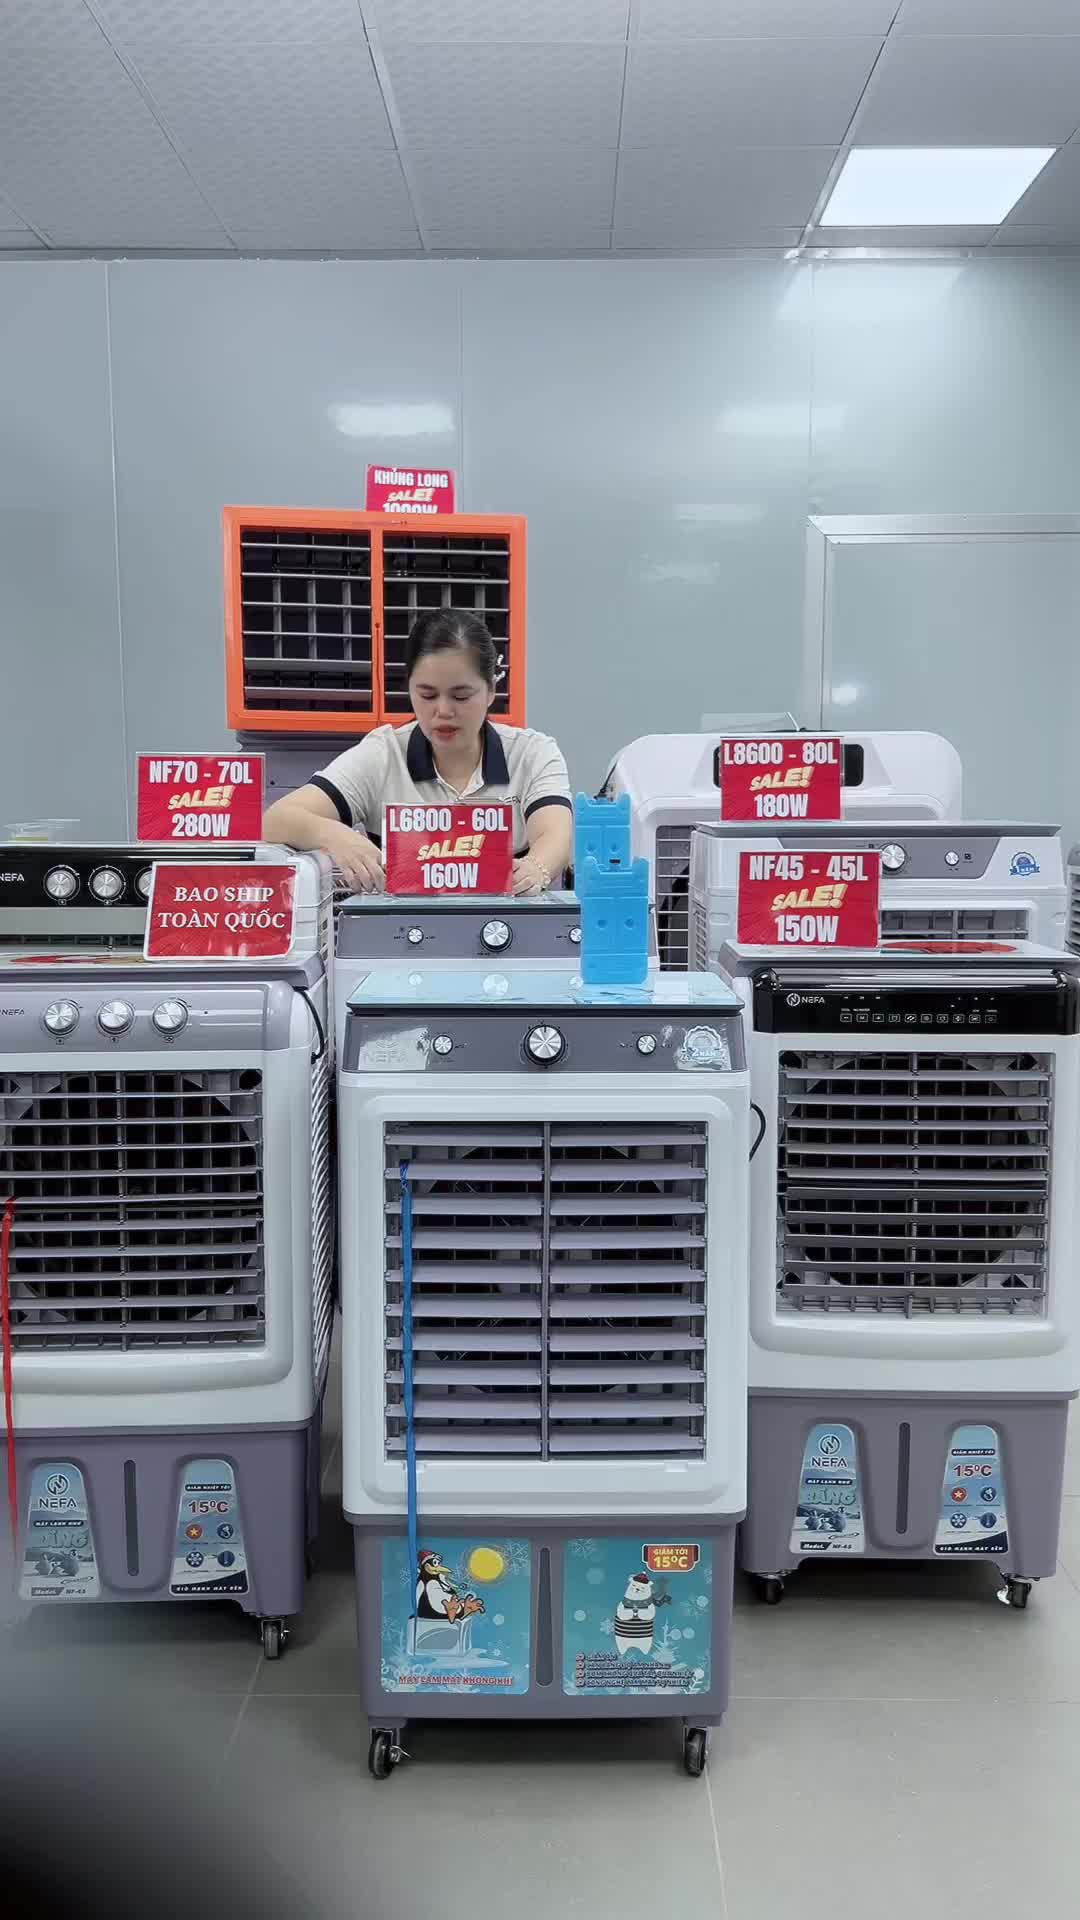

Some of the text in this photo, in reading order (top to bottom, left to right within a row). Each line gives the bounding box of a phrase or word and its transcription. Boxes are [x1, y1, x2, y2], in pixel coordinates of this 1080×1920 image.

[374, 468, 448, 488] KHỦNG LONG
[724, 743, 783, 765] L8600
[802, 742, 838, 764] 80L
[149, 760, 198, 783] NF70
[218, 761, 254, 784] 70L
[749, 766, 815, 791] SALE!
[167, 785, 236, 810] SALE!
[754, 793, 809, 817] 180W
[171, 813, 231, 837] 280W
[390, 808, 452, 832] L6800
[472, 808, 509, 832] 60L
[416, 834, 486, 861] SALE!
[421, 862, 479, 889] 160W
[749, 855, 804, 881] NF45
[826, 855, 869, 881] 45L
[173, 886, 275, 902] BAO SHIP
[770, 883, 848, 911] SALE!
[158, 908, 286, 933] TOÀN QUỐC
[774, 914, 839, 943] 150W
[800, 996, 825, 1004] NEFA
[812, 1457, 848, 1467] NEFA
[39, 1498, 77, 1508] NEFA
